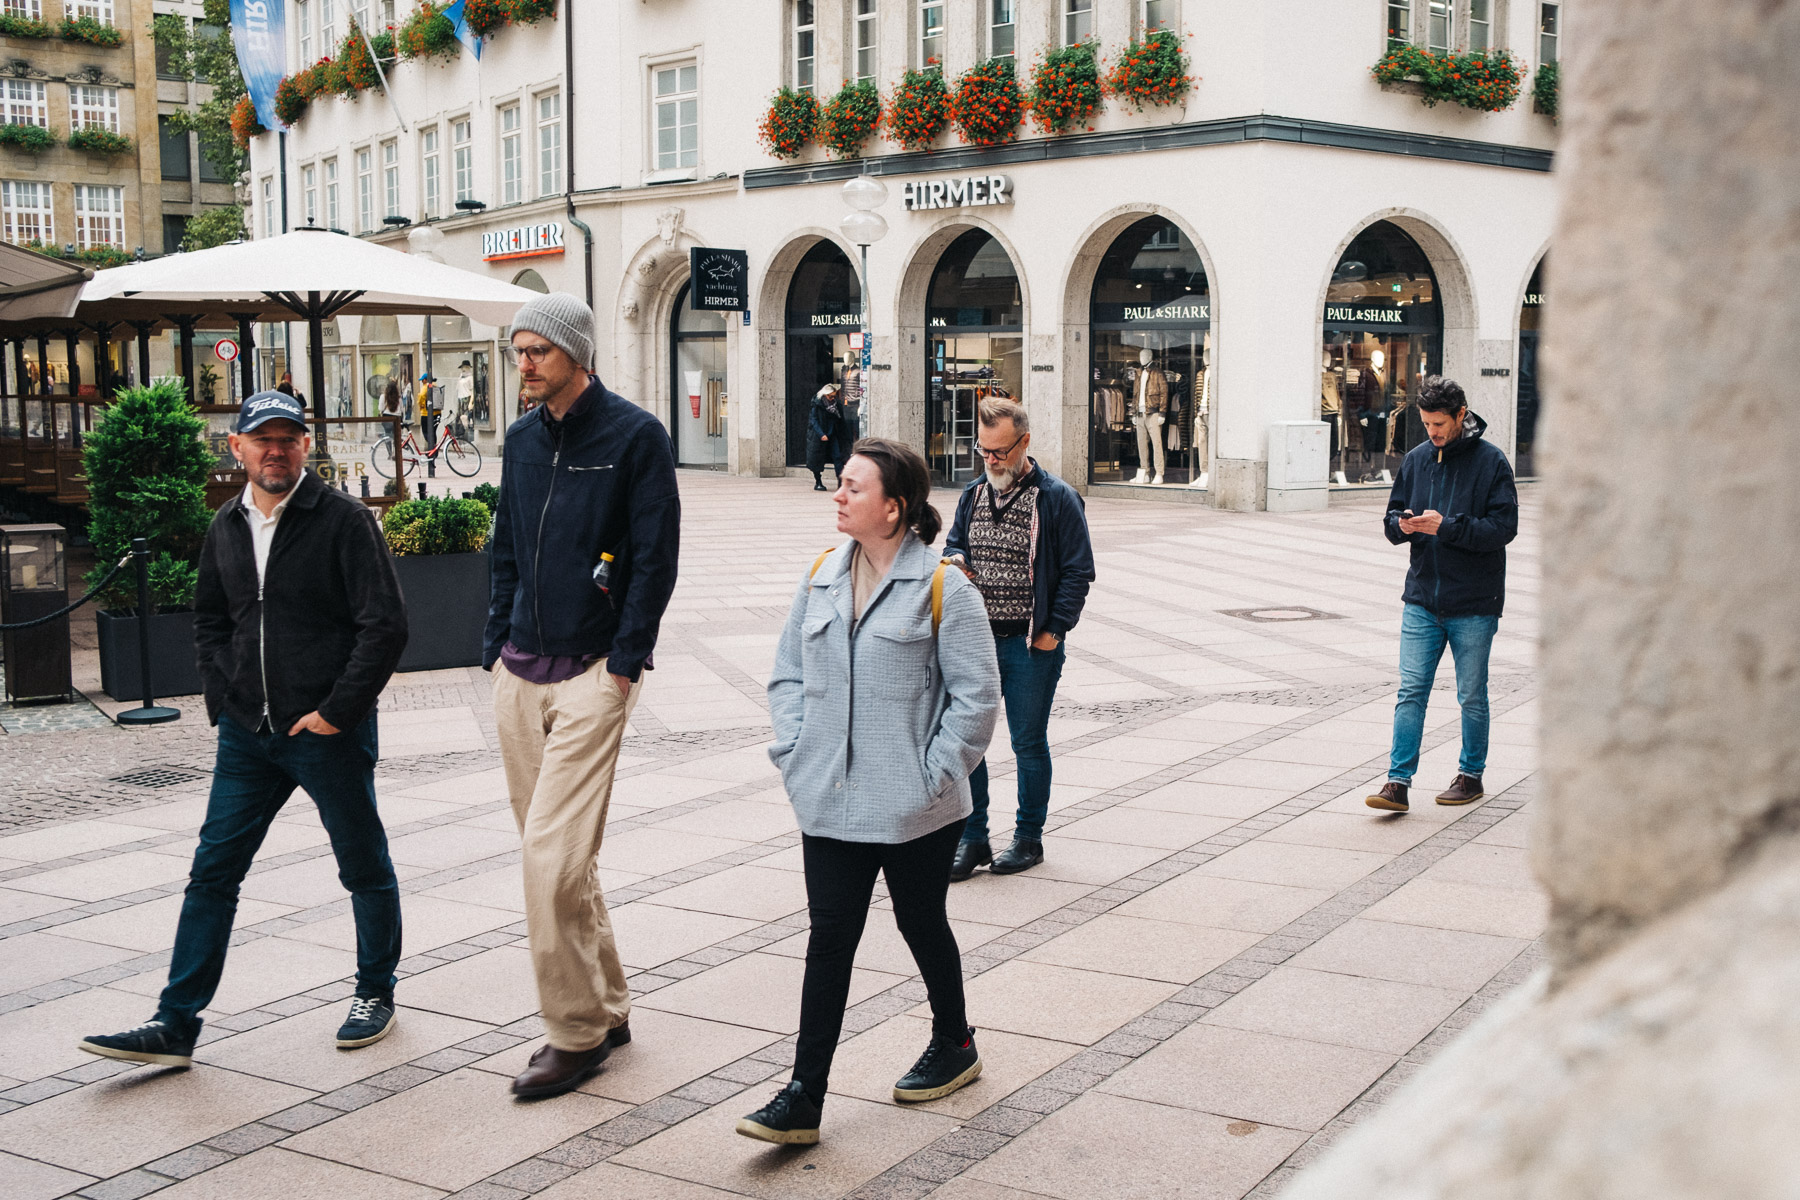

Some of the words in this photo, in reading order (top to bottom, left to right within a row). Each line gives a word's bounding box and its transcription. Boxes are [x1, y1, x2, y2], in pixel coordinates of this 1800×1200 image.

[900, 175, 1007, 211] HIRMER
[482, 223, 564, 255] BREITER
[704, 296, 739, 306] HIRMER
[1481, 368, 1510, 377] HIRMER
[247, 397, 301, 417] Titleist
